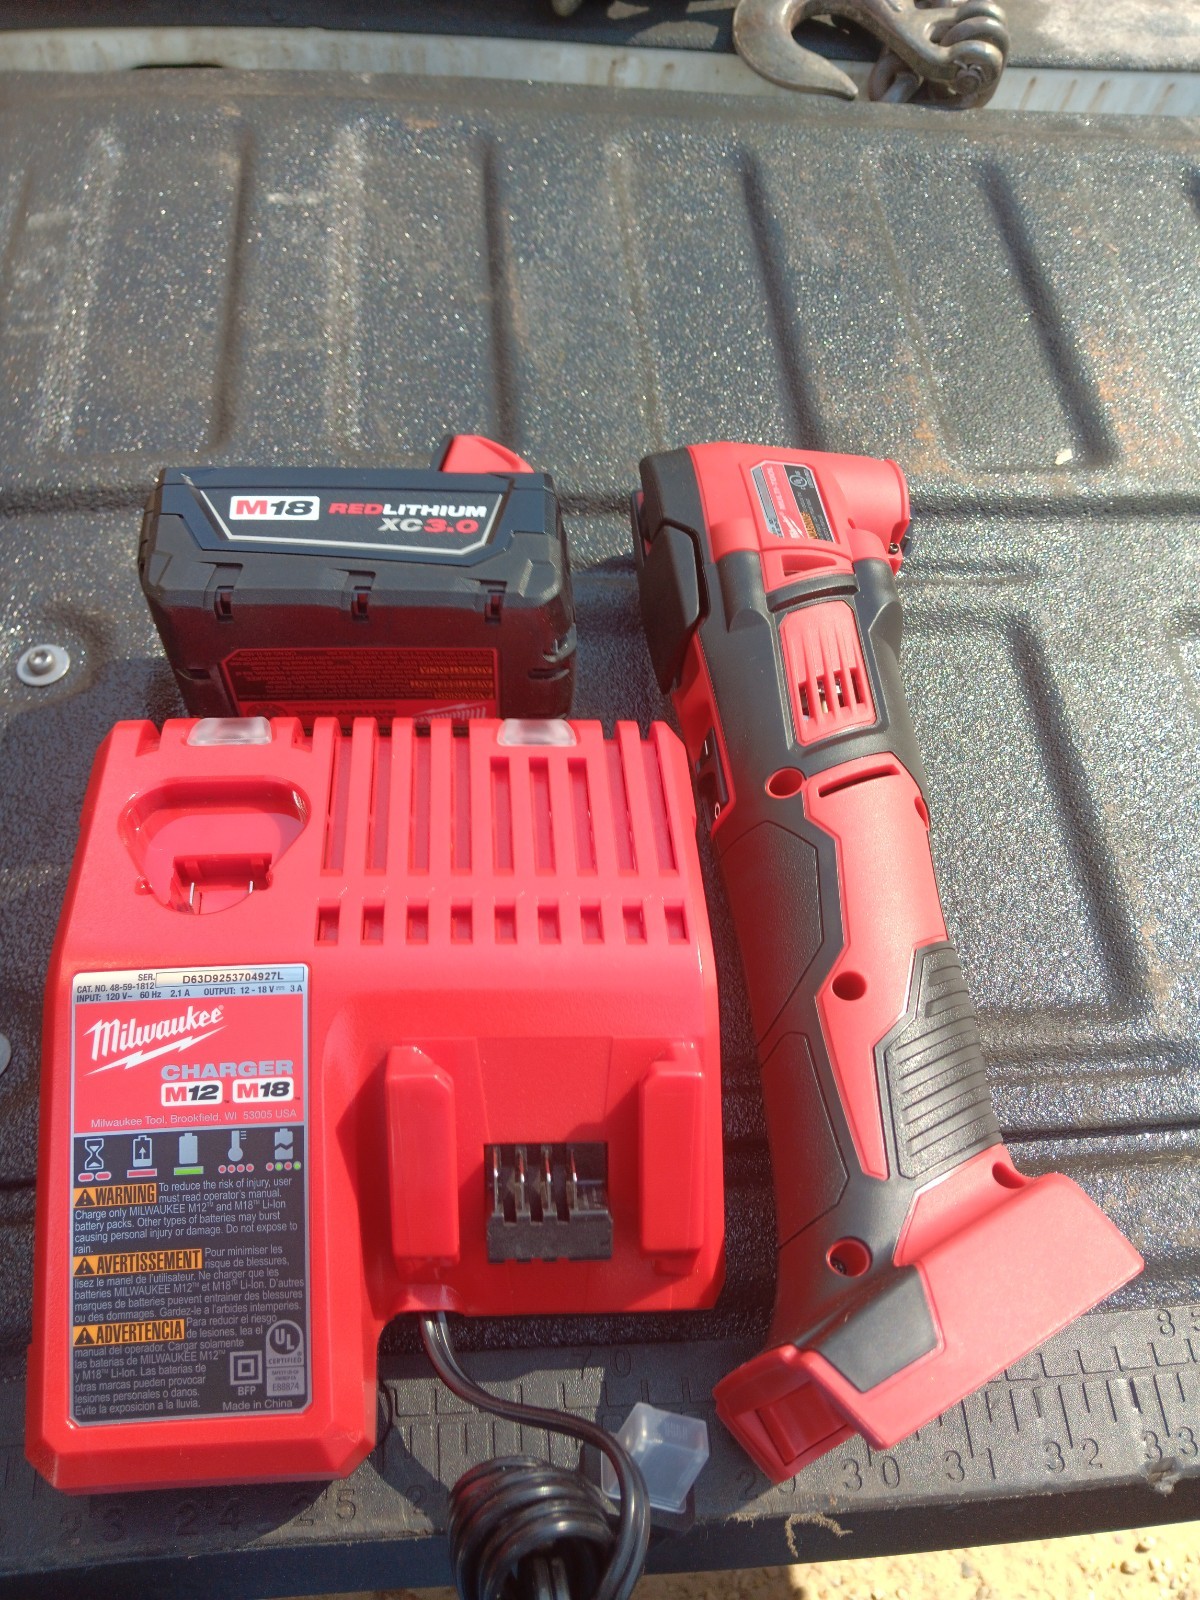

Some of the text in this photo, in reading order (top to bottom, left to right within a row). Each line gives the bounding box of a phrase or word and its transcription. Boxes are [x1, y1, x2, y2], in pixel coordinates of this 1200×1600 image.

[235, 499, 487, 518] M18 REDLITHIUM
[183, 972, 284, 984] D63D9253704927L
[77, 982, 155, 993] CAT. NO. 48-59-1812
[77, 994, 101, 1003] INPUT:
[140, 991, 151, 999] 60
[204, 988, 236, 996] OUTPUT:
[241, 986, 250, 994] 12
[297, 984, 303, 992] A
[83, 1005, 224, 1061] Milwaukee
[161, 1060, 293, 1080] CHARGER
[165, 1082, 290, 1102] M12 M18
[91, 1117, 142, 1128] Milwaukee
[225, 1112, 236, 1120] WI
[244, 1111, 272, 1119] 53005
[276, 1110, 296, 1118] USA
[159, 1178, 292, 1191] To reduce the risk of injury, user
[95, 1185, 155, 1205] WARNING
[159, 1189, 281, 1202] must read operator's manual.
[75, 1210, 106, 1221] Charge
[109, 1209, 127, 1219] only
[129, 1204, 185, 1216] MILWAUKEE
[216, 1202, 232, 1211] and
[75, 1211, 280, 1232] battery packs. Other types of batteries may burst
[75, 1233, 108, 1243] causing
[111, 1230, 147, 1241] personal
[150, 1229, 172, 1239] injury
[186, 1226, 223, 1236] damage.
[227, 1225, 238, 1233] Do
[241, 1224, 254, 1232] not
[257, 1223, 287, 1234] expose
[290, 1223, 297, 1231] to
[75, 1245, 93, 1254] rain.
[205, 1245, 282, 1257] Pour minimiser les
[97, 1250, 200, 1274] AVERTISSEMENT
[205, 1257, 289, 1269] risque de blessures,
[75, 1268, 279, 1288] lisez le manel de l'utilisateur. Ne charger que les
[75, 1290, 111, 1299] batteries
[114, 1285, 171, 1297] MILWAUKEE
[202, 1283, 210, 1291] et
[269, 1278, 304, 1288] D'autres
[186, 1314, 277, 1326] Para reducir el riesgo
[96, 1321, 182, 1344] ADVERTENCIA
[186, 1330, 197, 1338] de
[240, 1326, 253, 1335] lea
[255, 1325, 263, 1334] el
[275, 1328, 295, 1350] UL
[75, 1339, 244, 1358] manual del operador. Cargar solamente
[75, 1351, 197, 1369] las baterias de MILWAUKEE
[140, 1367, 156, 1375] Las
[159, 1364, 192, 1374] baterias
[195, 1364, 206, 1372] de
[75, 1375, 205, 1393] otras marcas pueden provocar
[238, 1386, 256, 1396] BFP
[75, 1394, 110, 1404] lesiones
[112, 1390, 160, 1401] personales
[223, 1400, 292, 1411] Made in China
[75, 1398, 200, 1415] Evite la exposicion a la lluvia.
